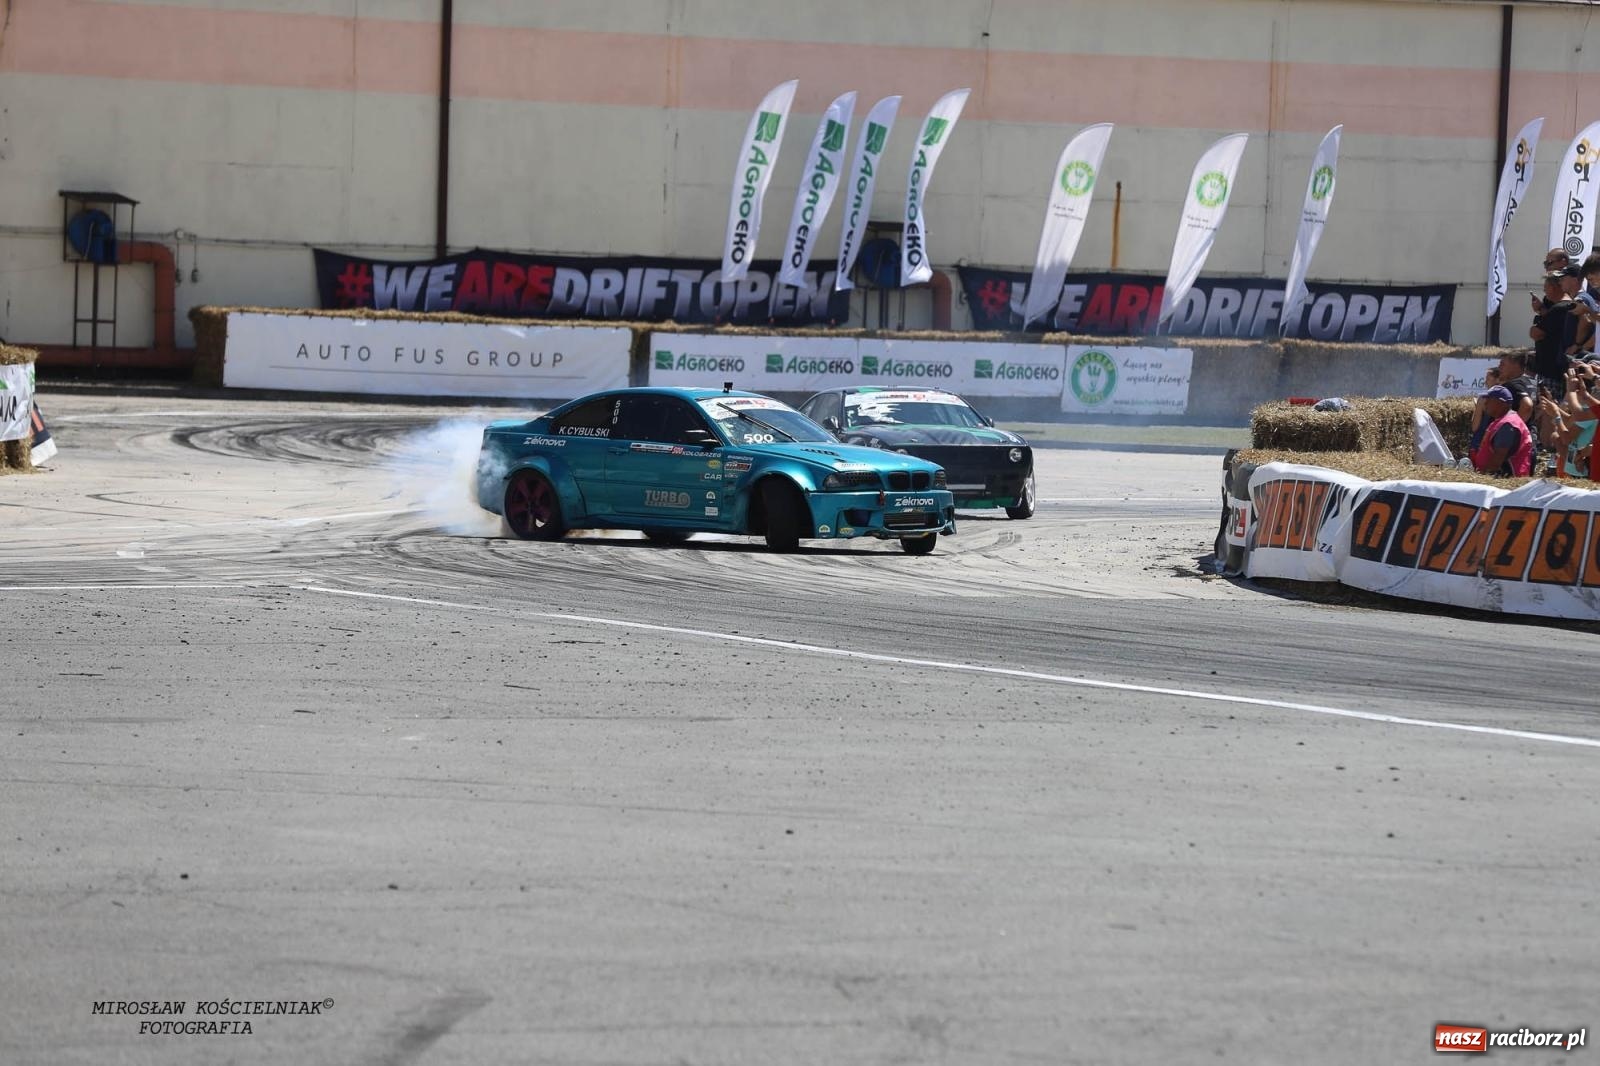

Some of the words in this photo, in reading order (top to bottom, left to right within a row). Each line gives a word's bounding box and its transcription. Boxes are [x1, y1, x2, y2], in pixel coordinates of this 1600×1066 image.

[296, 342, 372, 362] AUTO
[395, 346, 445, 365] FUS
[466, 351, 566, 369] GROUP
[675, 353, 745, 372] AGROEKO
[785, 356, 854, 374] AGROEKO
[880, 359, 953, 378] AGROEKO
[995, 361, 1059, 380] AGROEKO
[558, 426, 610, 438] K.CYBULSKI
[743, 433, 774, 443] 500
[645, 490, 690, 507] TURBO
